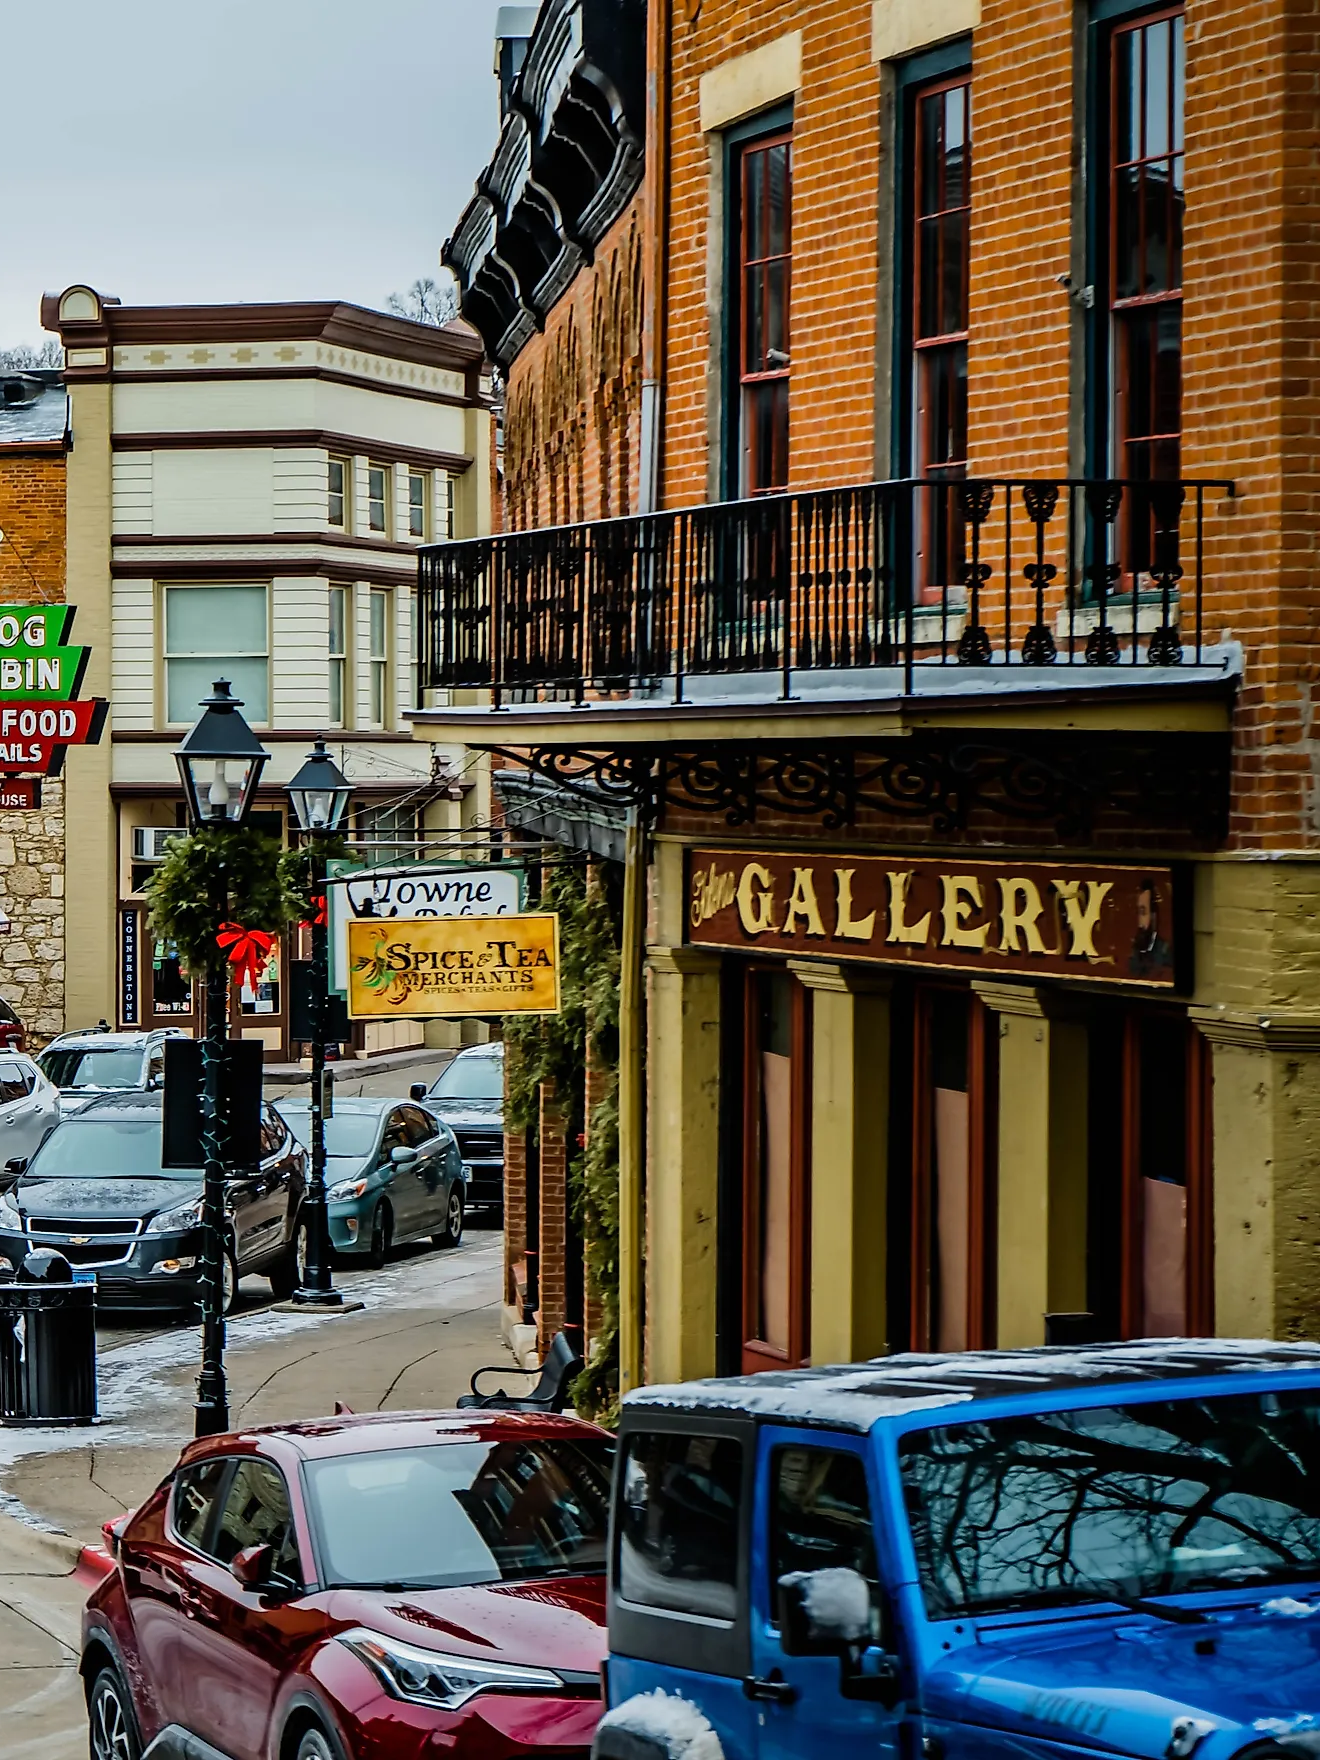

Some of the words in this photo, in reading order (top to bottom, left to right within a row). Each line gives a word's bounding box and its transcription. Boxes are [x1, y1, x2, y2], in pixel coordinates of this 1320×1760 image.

[1, 709, 77, 737] FOOD
[737, 862, 1116, 960] GALLERY
[125, 916, 134, 1021] CORNERSTONE
[386, 942, 473, 972] SPICE
[486, 940, 553, 969] TEA
[402, 970, 534, 989] MERCHANTS
[424, 986, 461, 995] SPICES
[467, 985, 496, 994] TEAS
[502, 984, 535, 993] GIFTS
